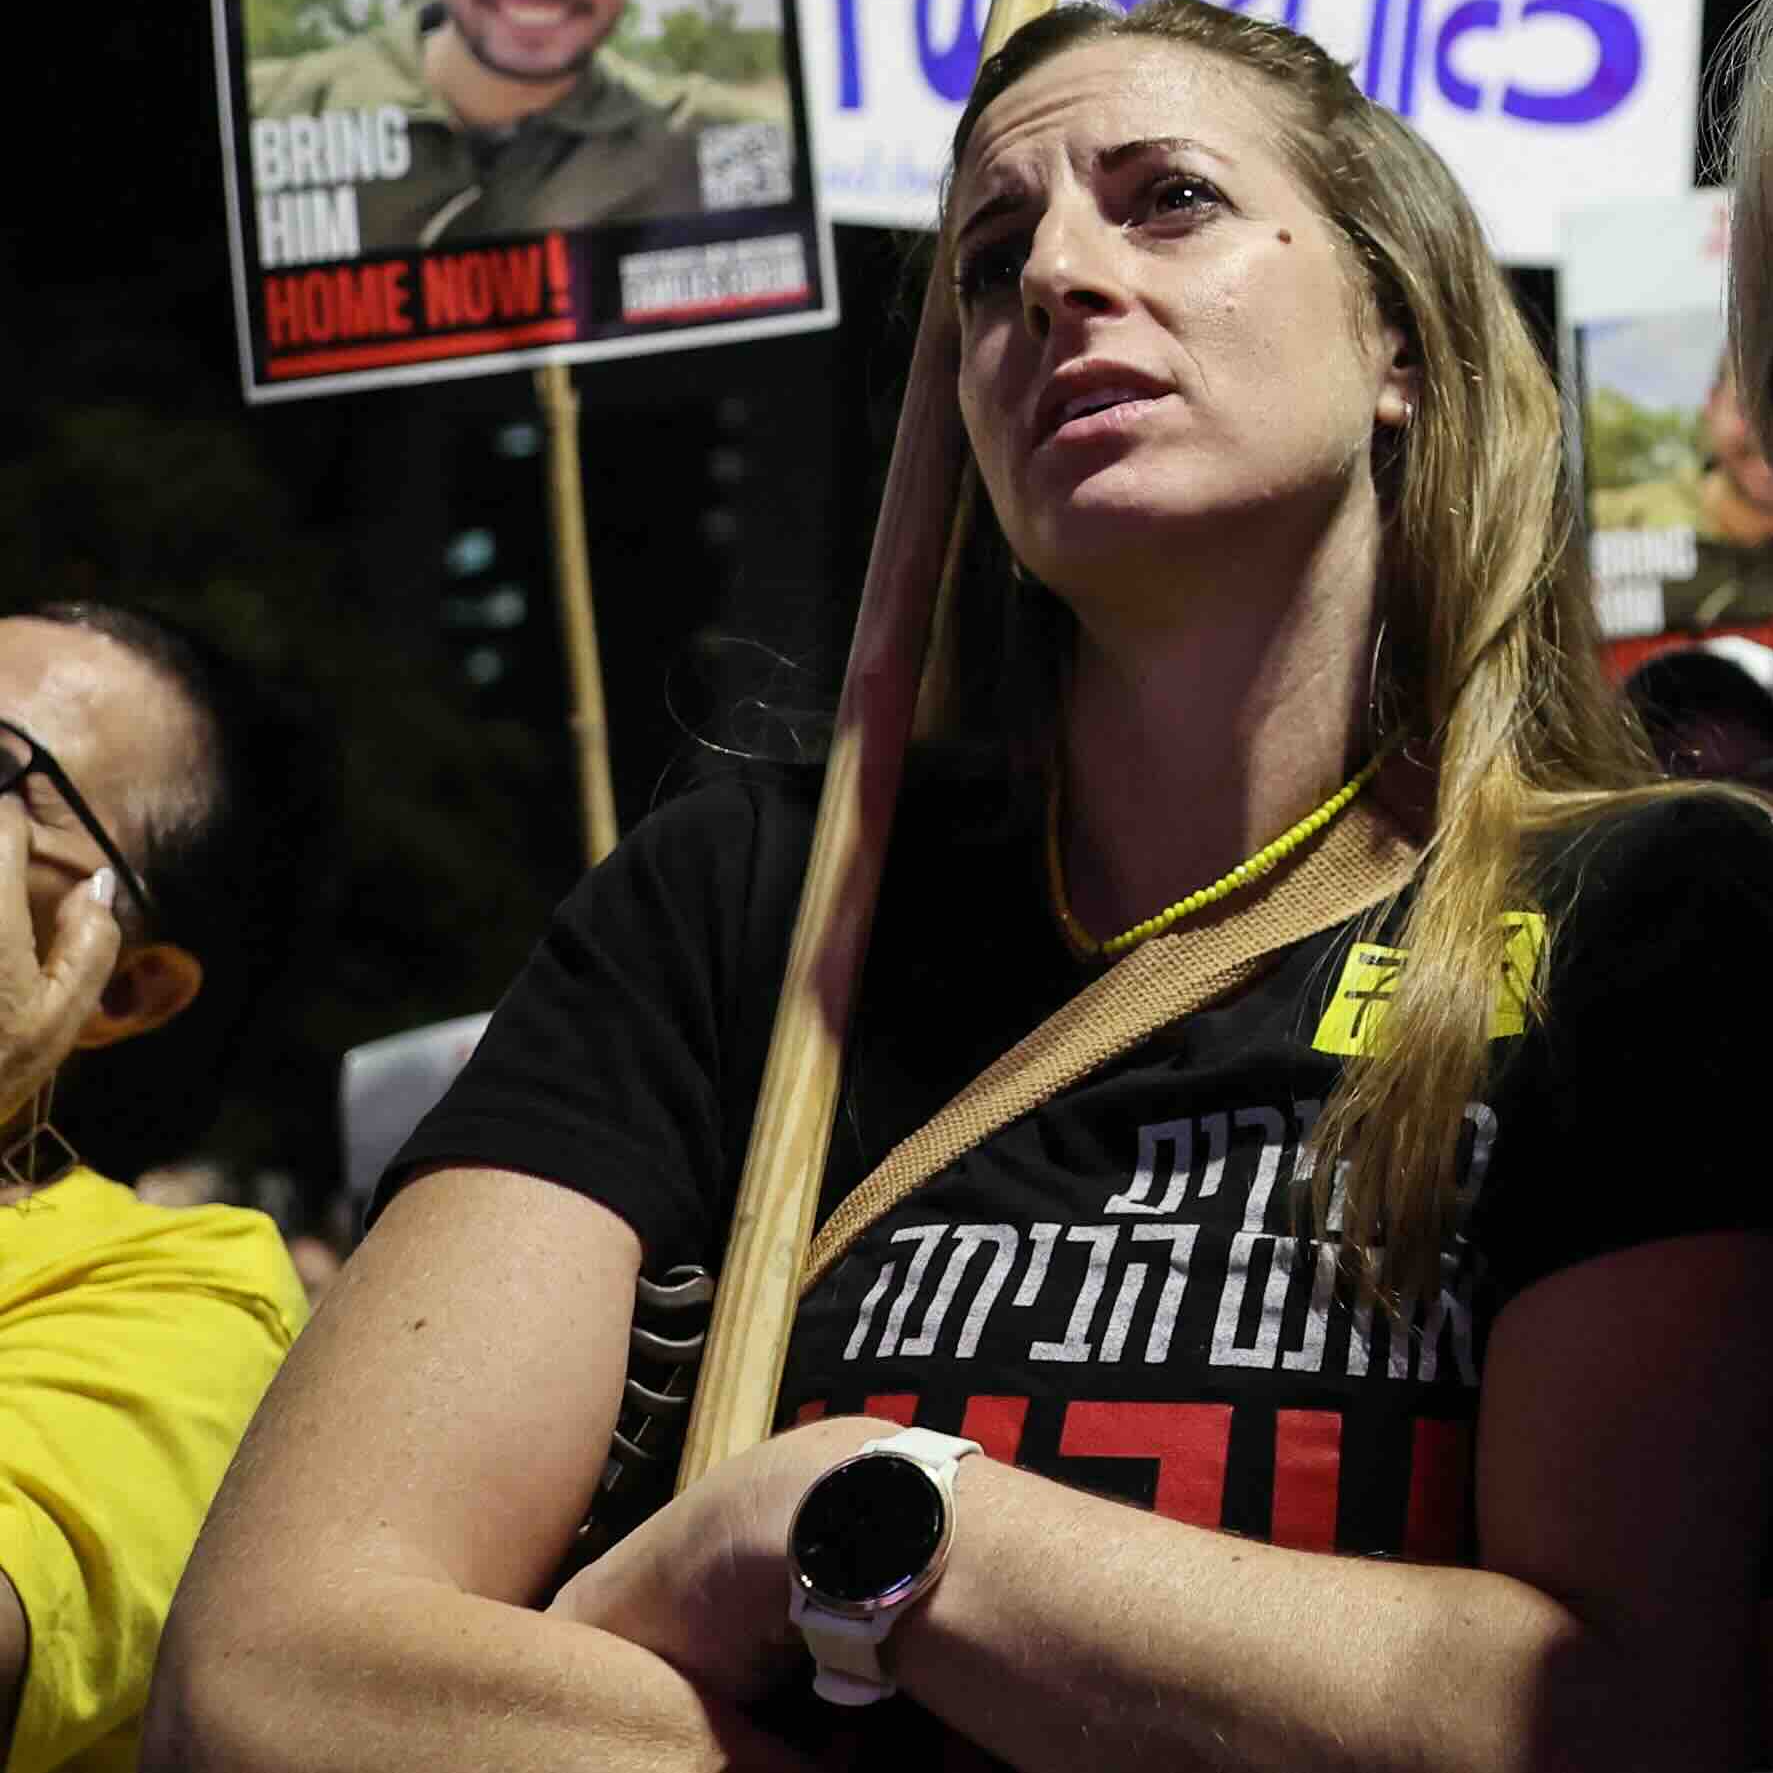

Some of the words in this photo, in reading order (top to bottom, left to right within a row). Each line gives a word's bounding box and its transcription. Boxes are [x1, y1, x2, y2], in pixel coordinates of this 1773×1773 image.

[250, 106, 412, 192] BRING
[257, 184, 361, 270] HIM
[264, 259, 411, 347] HOME
[421, 231, 572, 327] NOW!
[843, 1222, 1202, 1364] הביתה
